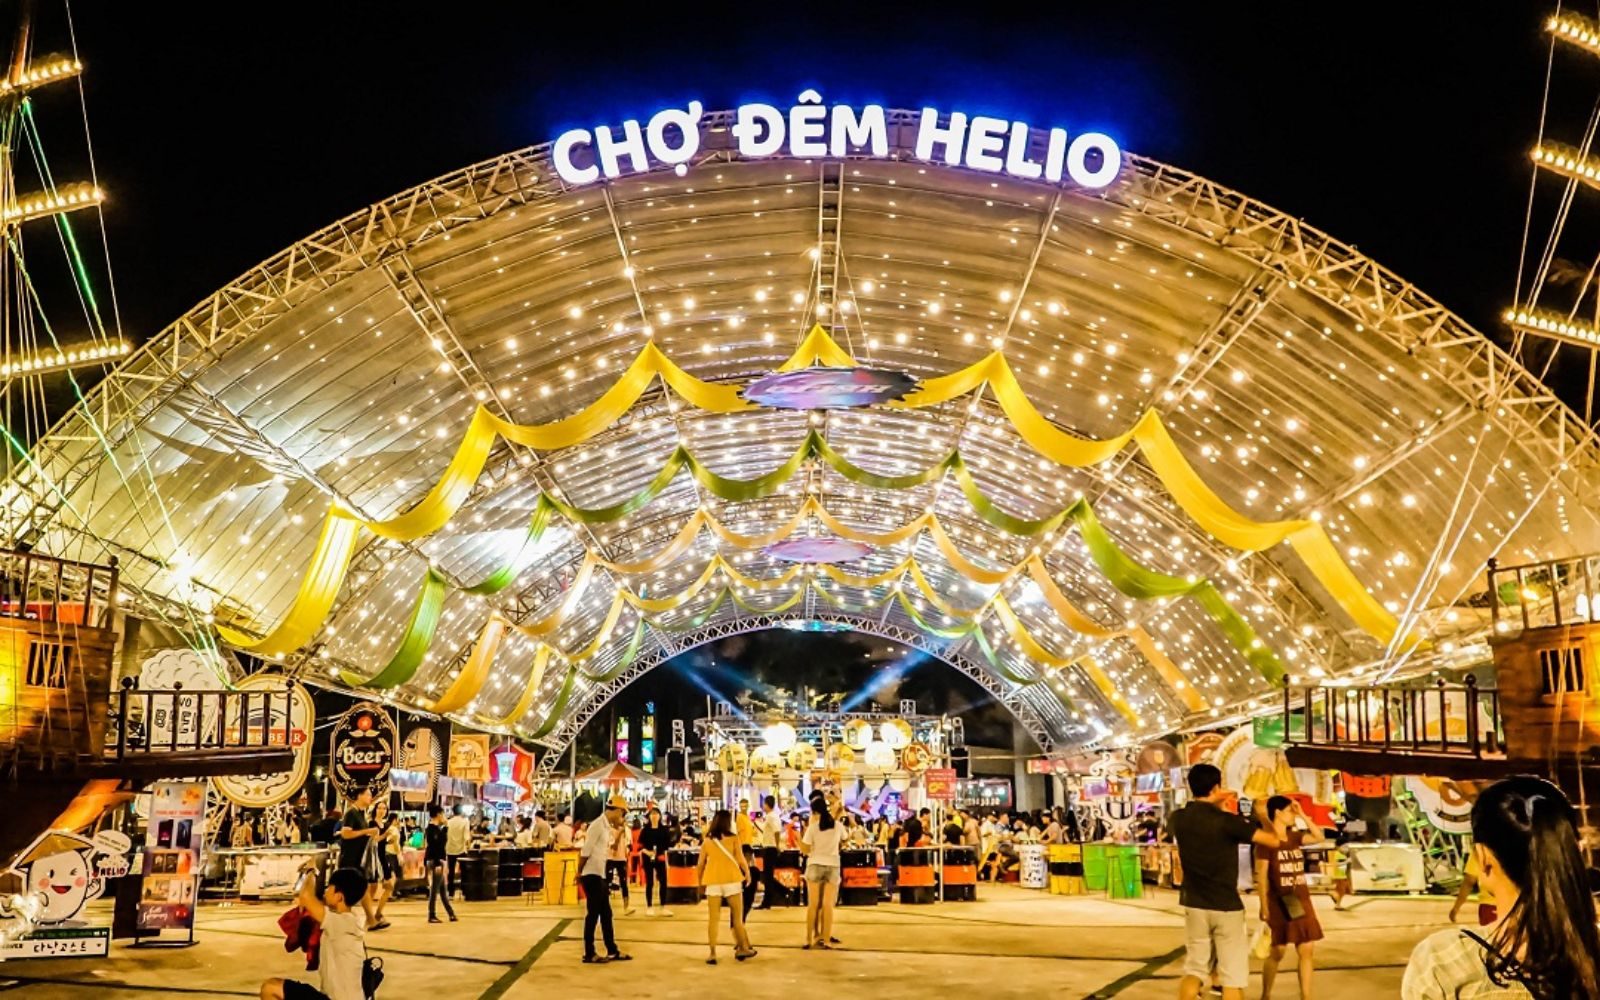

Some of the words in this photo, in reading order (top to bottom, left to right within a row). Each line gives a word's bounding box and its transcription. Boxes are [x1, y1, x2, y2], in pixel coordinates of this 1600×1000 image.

[552, 100, 704, 184] CHỢ
[731, 89, 889, 158] ĐÊM
[914, 107, 1122, 189] HELIO
[269, 733, 302, 744] BER
[343, 746, 386, 765] Beer
